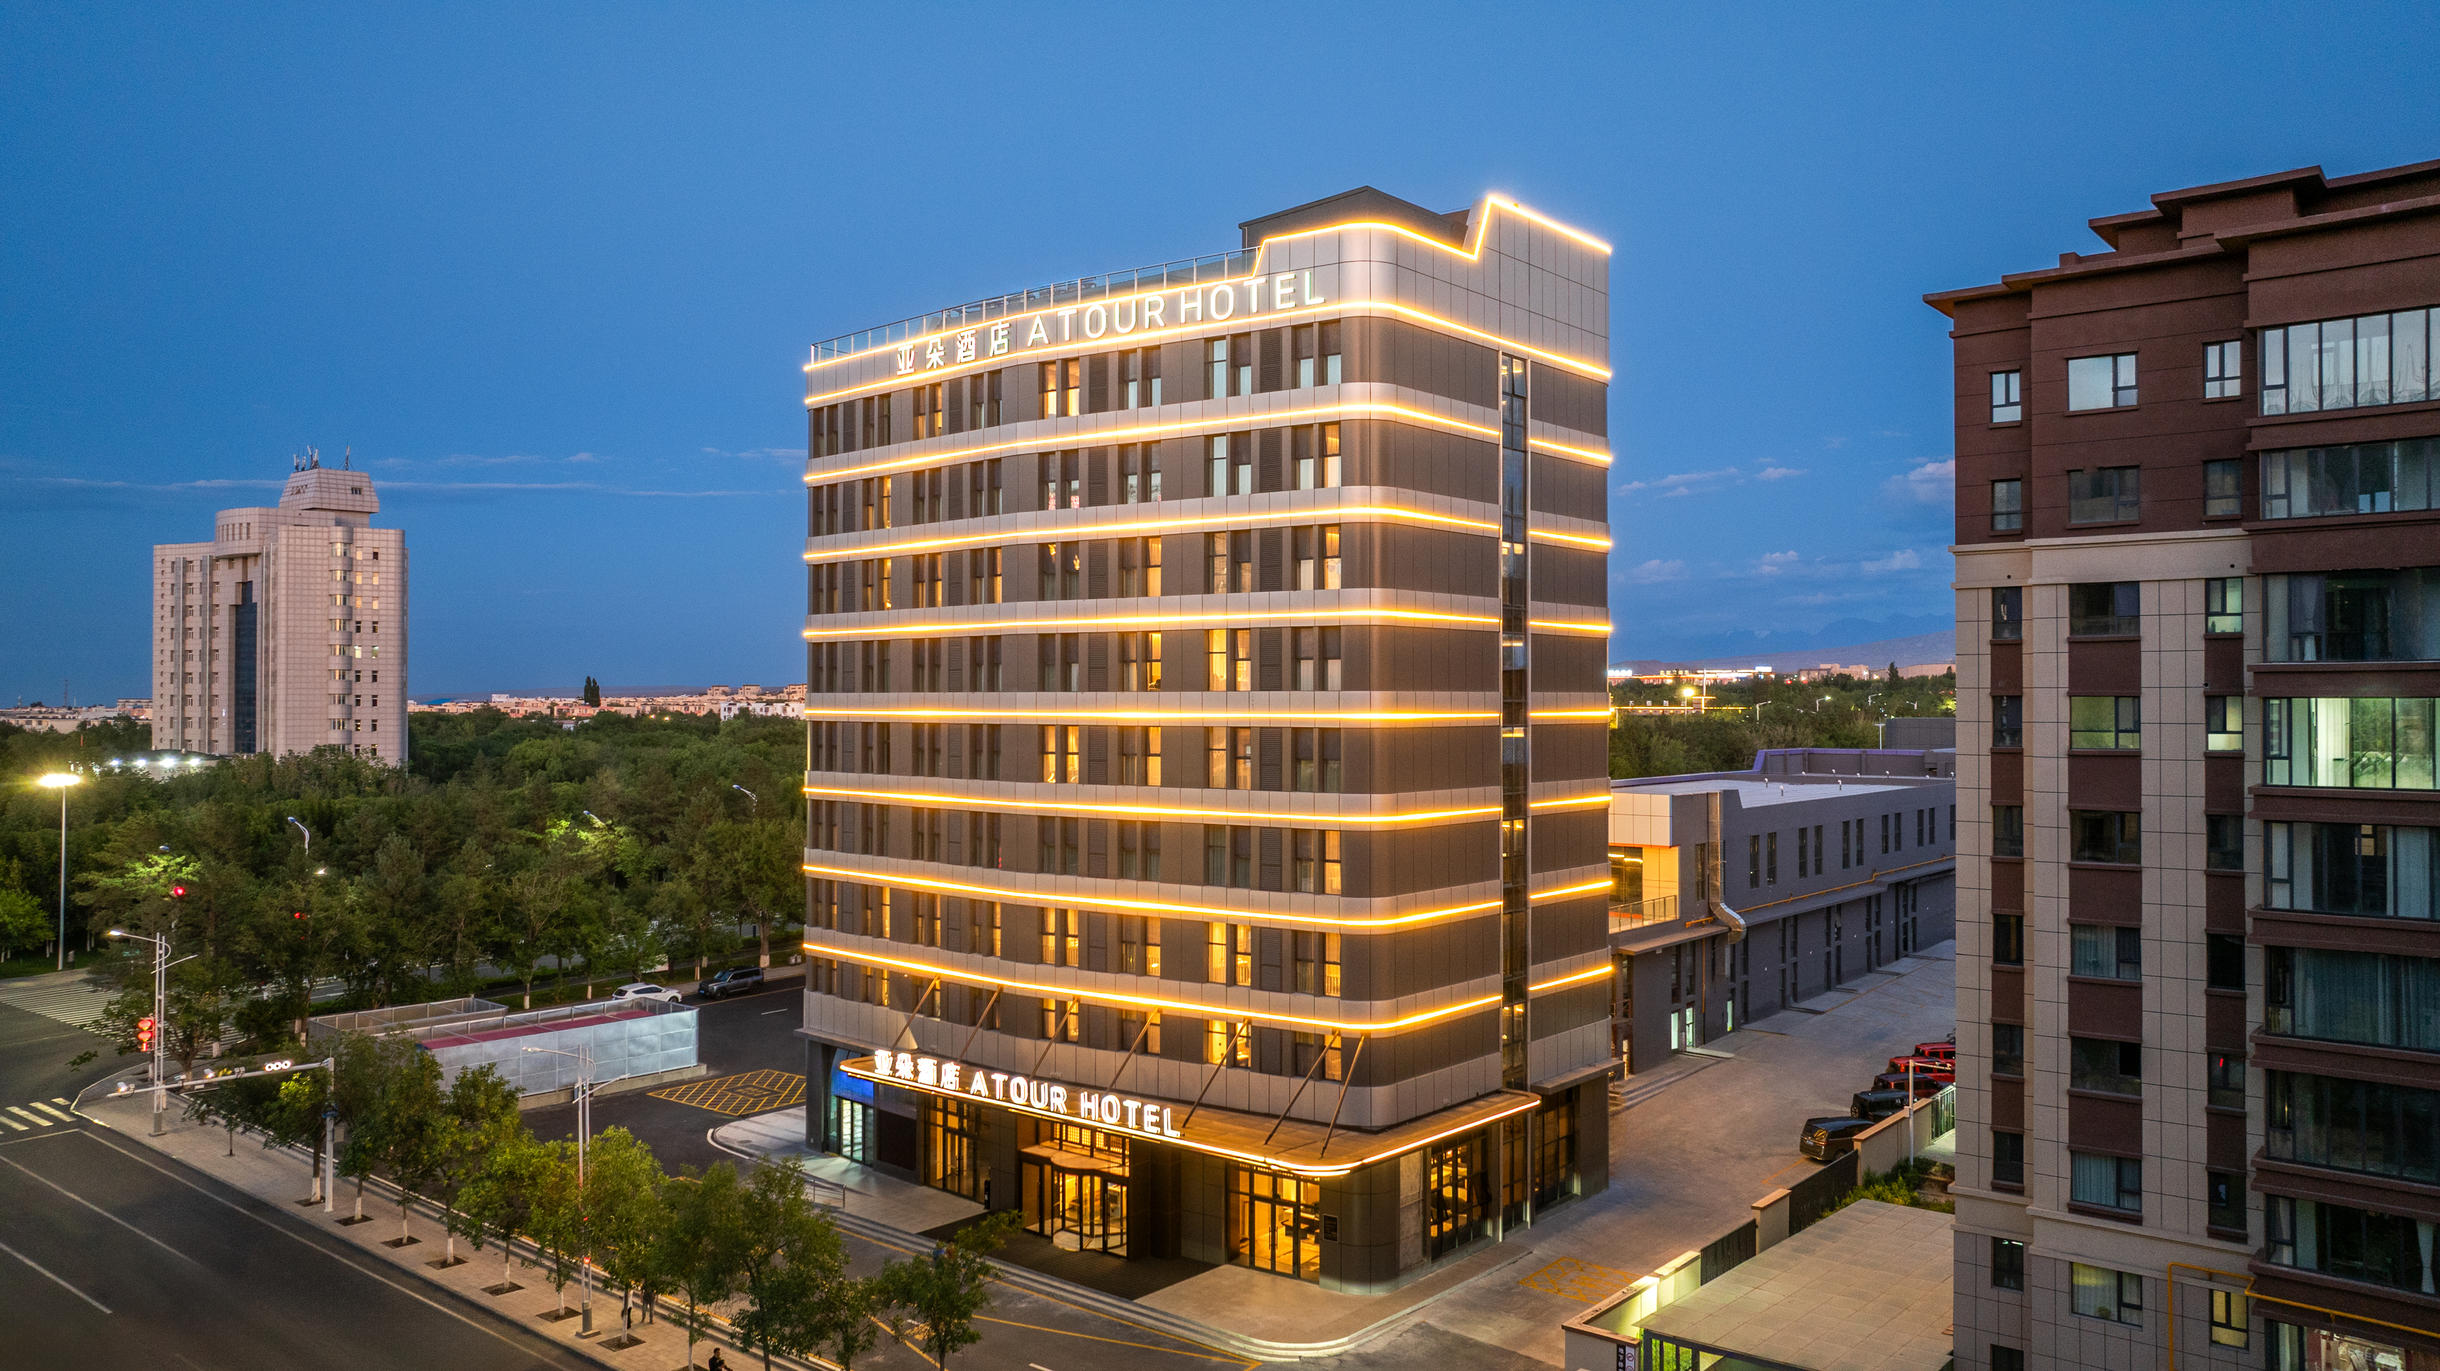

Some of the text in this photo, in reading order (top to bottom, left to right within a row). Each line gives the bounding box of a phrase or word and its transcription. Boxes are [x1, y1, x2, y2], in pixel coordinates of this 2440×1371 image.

[1027, 271, 1325, 347] ATOUR HOTEL
[896, 320, 1010, 376] 亚朵酒店
[874, 1049, 960, 1091] 亚朵酒店
[970, 1070, 1181, 1137] ATOUR HOTEL
